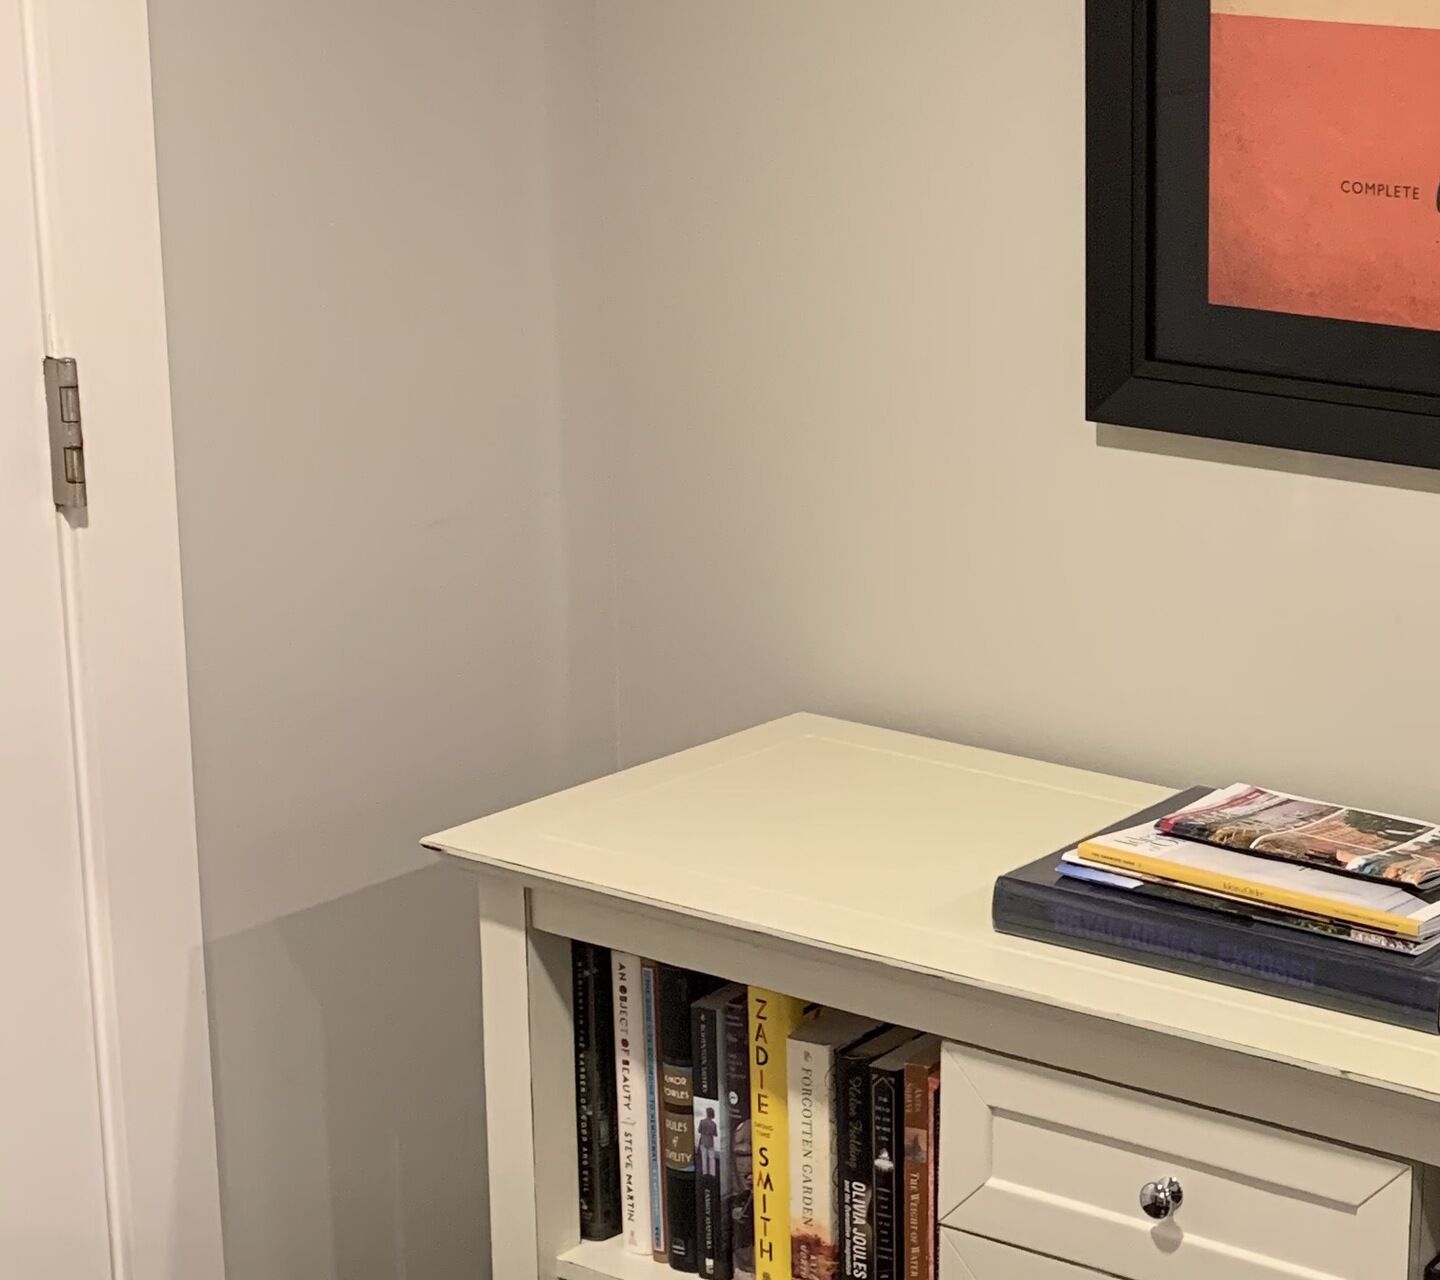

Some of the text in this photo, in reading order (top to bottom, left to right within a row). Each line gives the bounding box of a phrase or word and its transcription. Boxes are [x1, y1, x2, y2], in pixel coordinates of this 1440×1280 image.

[1340, 179, 1421, 201] COMPLETE
[618, 962, 632, 1111] AN OBJECT OF BEAUTY
[755, 998, 769, 1115] ZADIE
[624, 1131, 635, 1222] STEVE MARTIN
[801, 1067, 813, 1227] FORGOTTEN GARDEN
[757, 1147, 774, 1262] SMITH
[851, 1180, 868, 1280] OLIVIA JOULES
[909, 1172, 920, 1278] THE WEIGHT OF WATER
